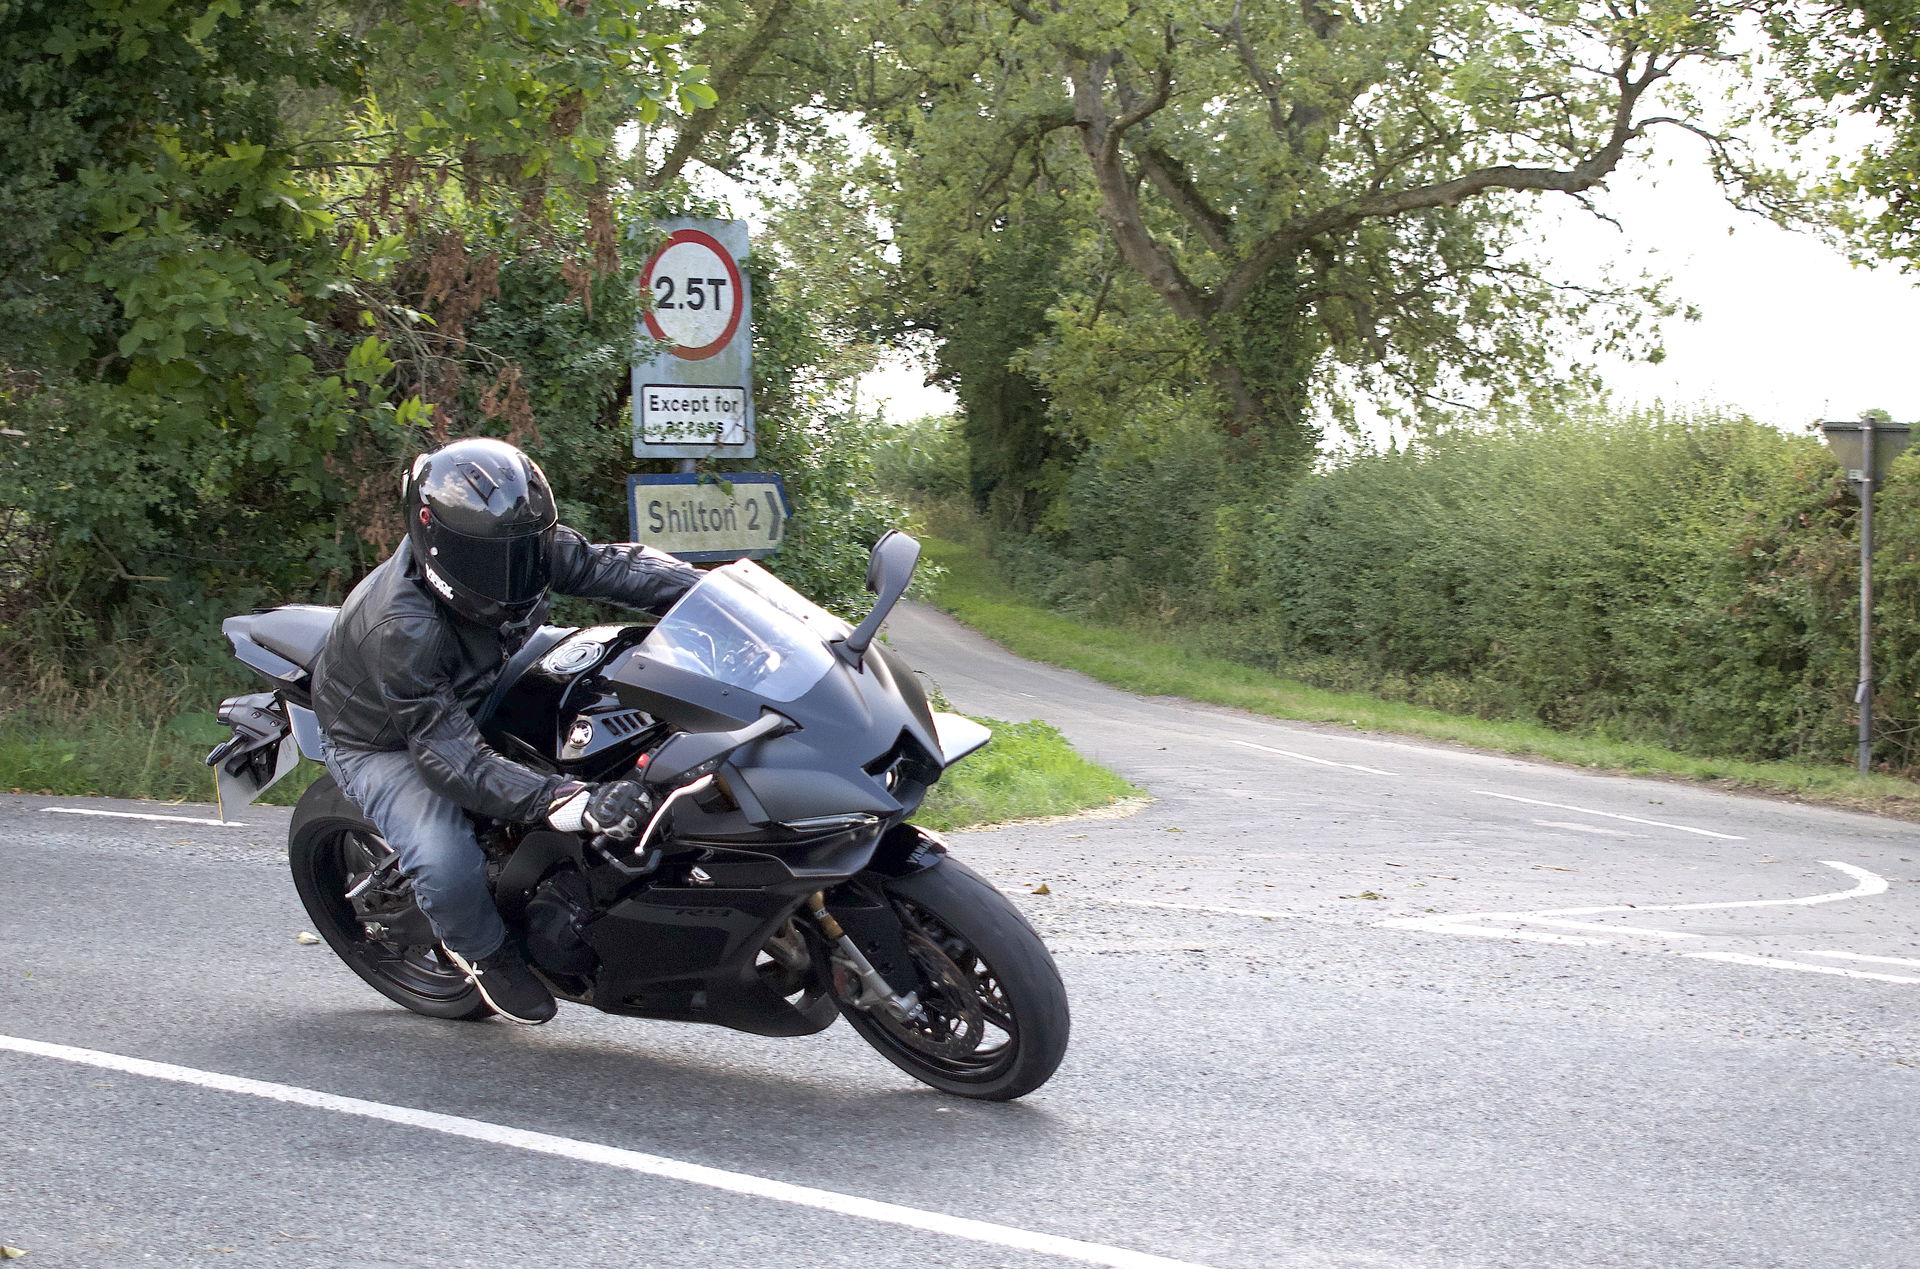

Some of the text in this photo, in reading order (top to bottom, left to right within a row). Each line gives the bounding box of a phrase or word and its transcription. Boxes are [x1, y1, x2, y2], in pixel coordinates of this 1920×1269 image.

[656, 276, 726, 310] 2.5T
[650, 394, 739, 415] Except for
[649, 498, 761, 533] Shilton 2
[906, 838, 936, 864] YAMA
